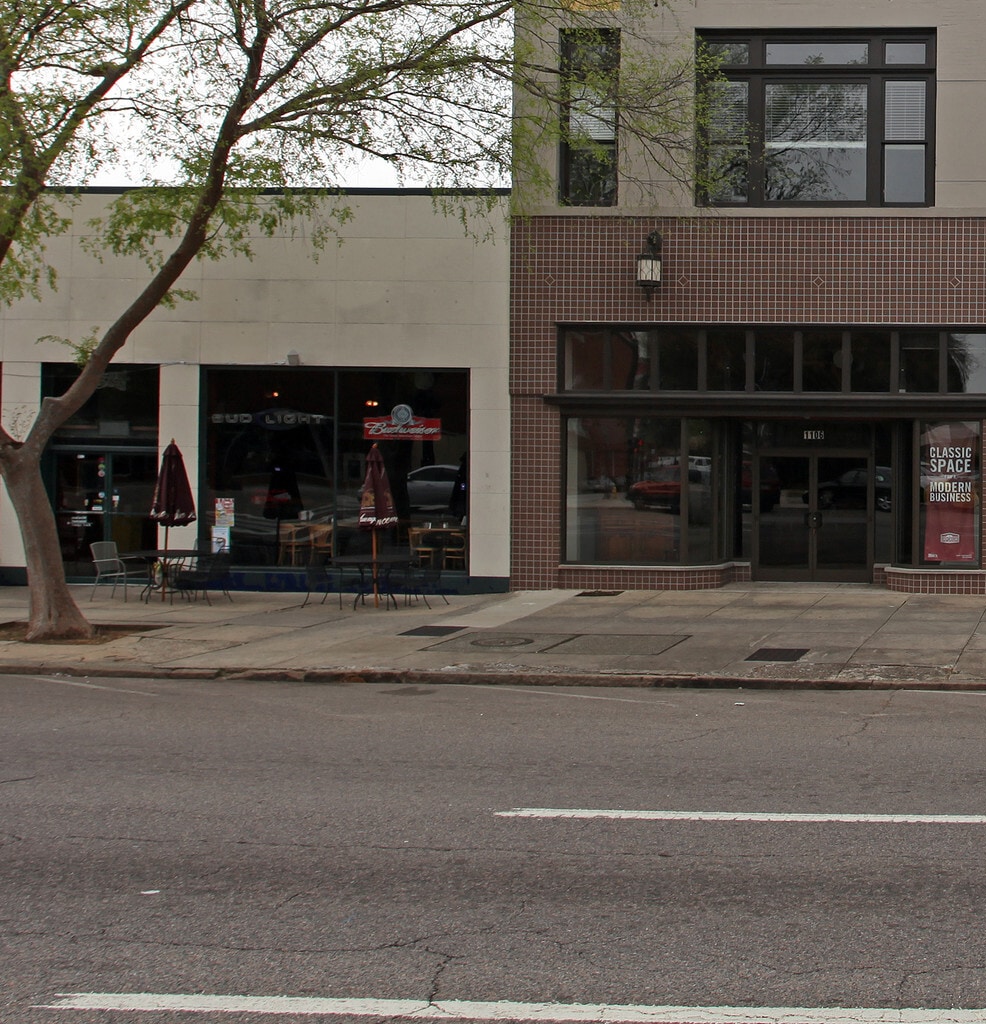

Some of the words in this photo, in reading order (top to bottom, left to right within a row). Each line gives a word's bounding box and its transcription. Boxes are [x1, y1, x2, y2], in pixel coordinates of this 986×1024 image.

[211, 413, 253, 424] BUD
[264, 414, 325, 424] LIGHT
[364, 422, 441, 435] Budweiser
[929, 446, 972, 458] CLASSIC
[929, 459, 972, 473] SPACE
[930, 481, 972, 493] MODERN
[930, 493, 971, 503] BUSINESS
